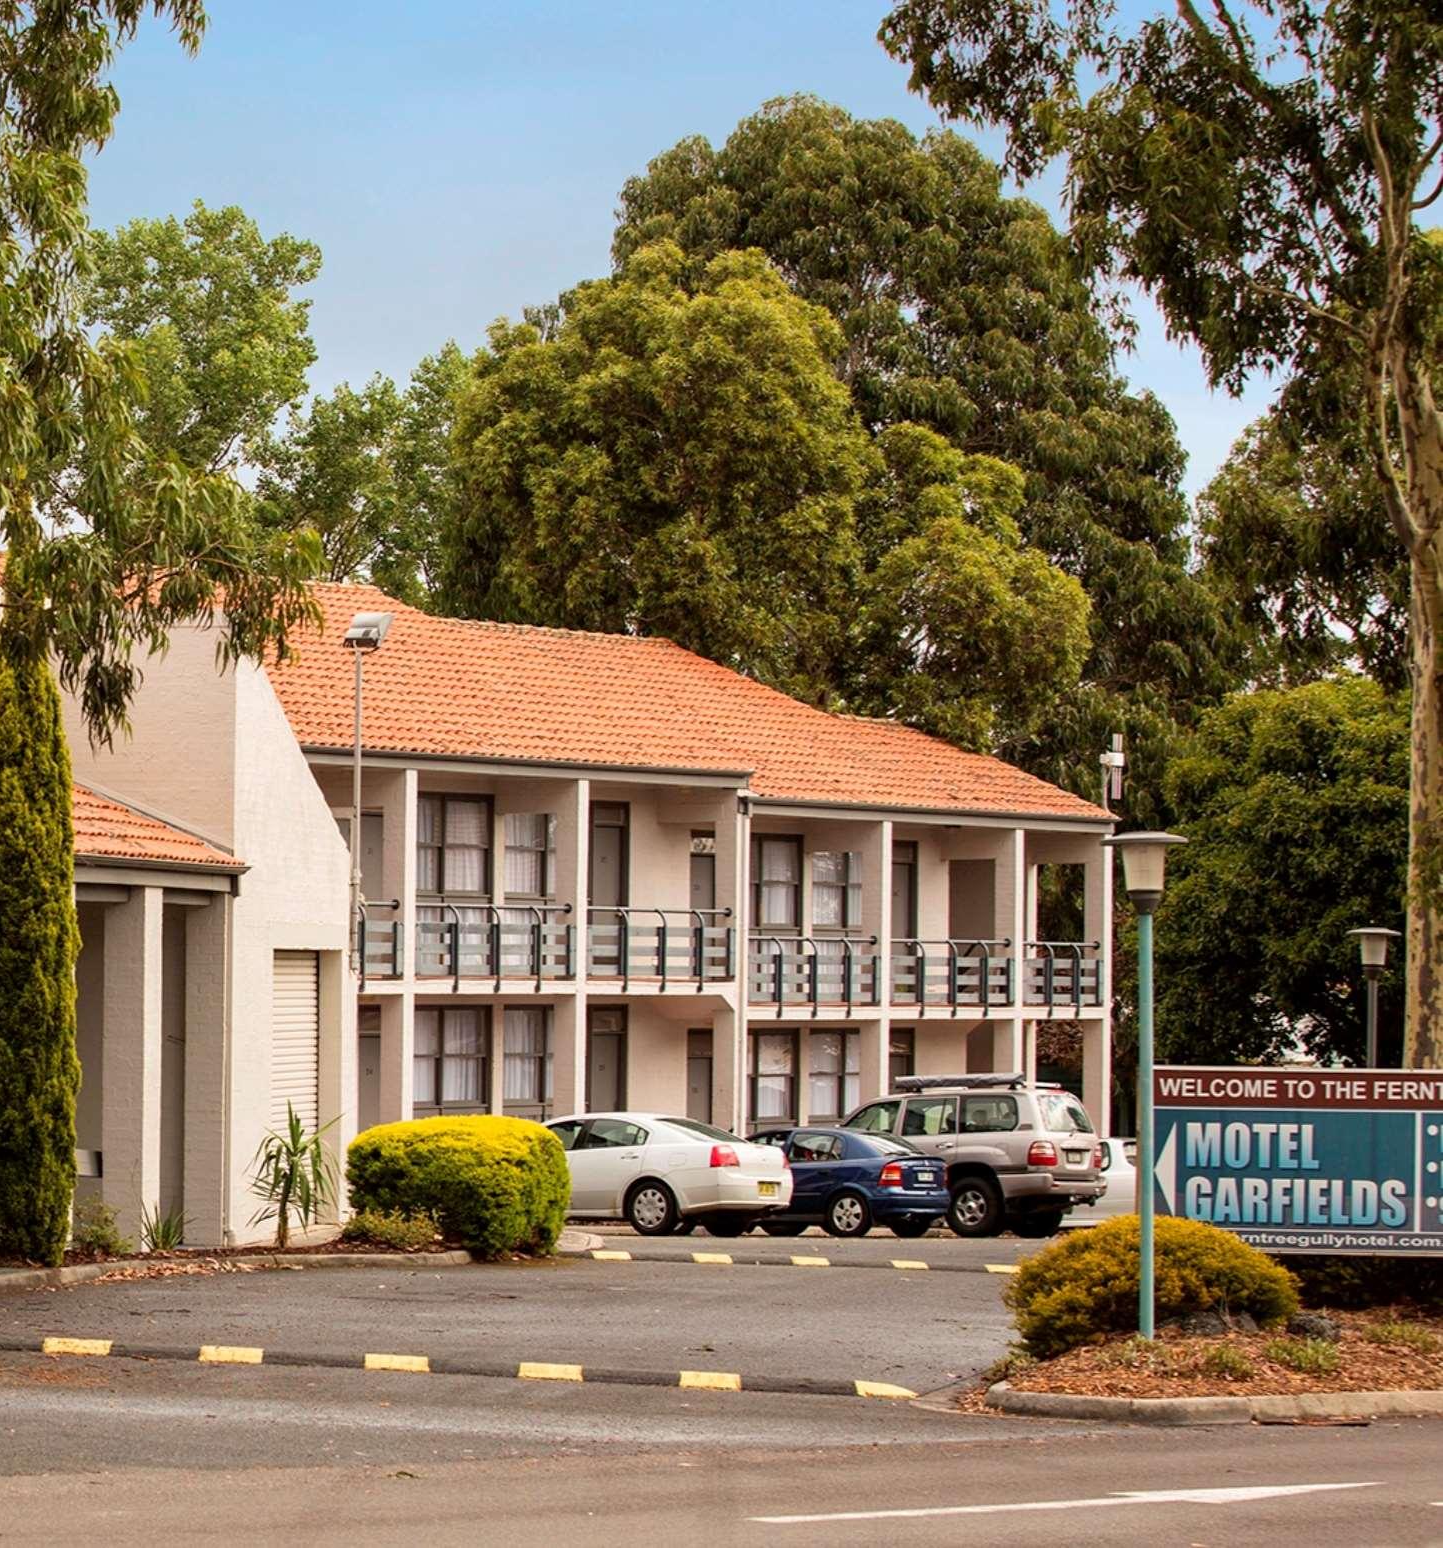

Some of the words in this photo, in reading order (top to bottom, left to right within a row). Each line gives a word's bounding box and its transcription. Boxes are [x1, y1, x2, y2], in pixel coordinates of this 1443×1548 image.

[1159, 1078, 1278, 1098] WELCOME
[1283, 1080, 1315, 1099] TO
[1324, 1081, 1366, 1099] THE
[1373, 1081, 1443, 1100] FERNT
[1185, 1122, 1319, 1169] MOTEL
[1185, 1176, 1405, 1226] GARFIELDS
[1241, 1233, 1443, 1247] rntreegullyhotel.com
